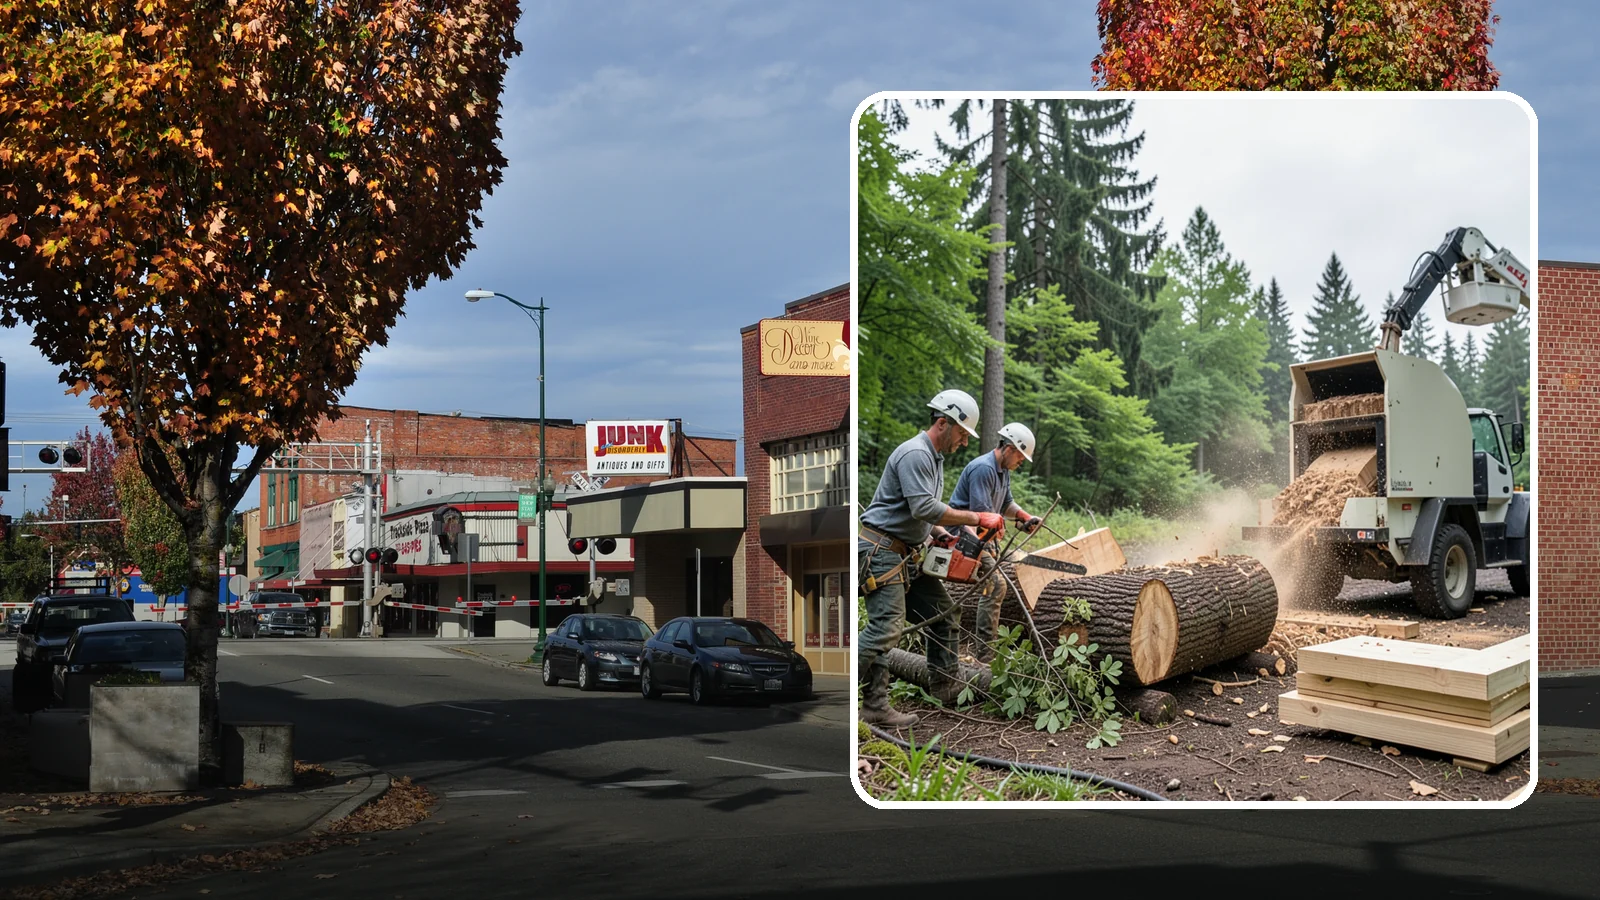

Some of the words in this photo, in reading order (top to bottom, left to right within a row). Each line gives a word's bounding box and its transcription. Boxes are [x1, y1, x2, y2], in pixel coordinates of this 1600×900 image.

[595, 425, 664, 457] JUNK
[607, 446, 646, 454] DISORDERLY
[596, 461, 628, 470] ANTIQUES
[631, 461, 644, 470] AND
[646, 460, 665, 470] GIFTS
[414, 519, 429, 535] Pizza
